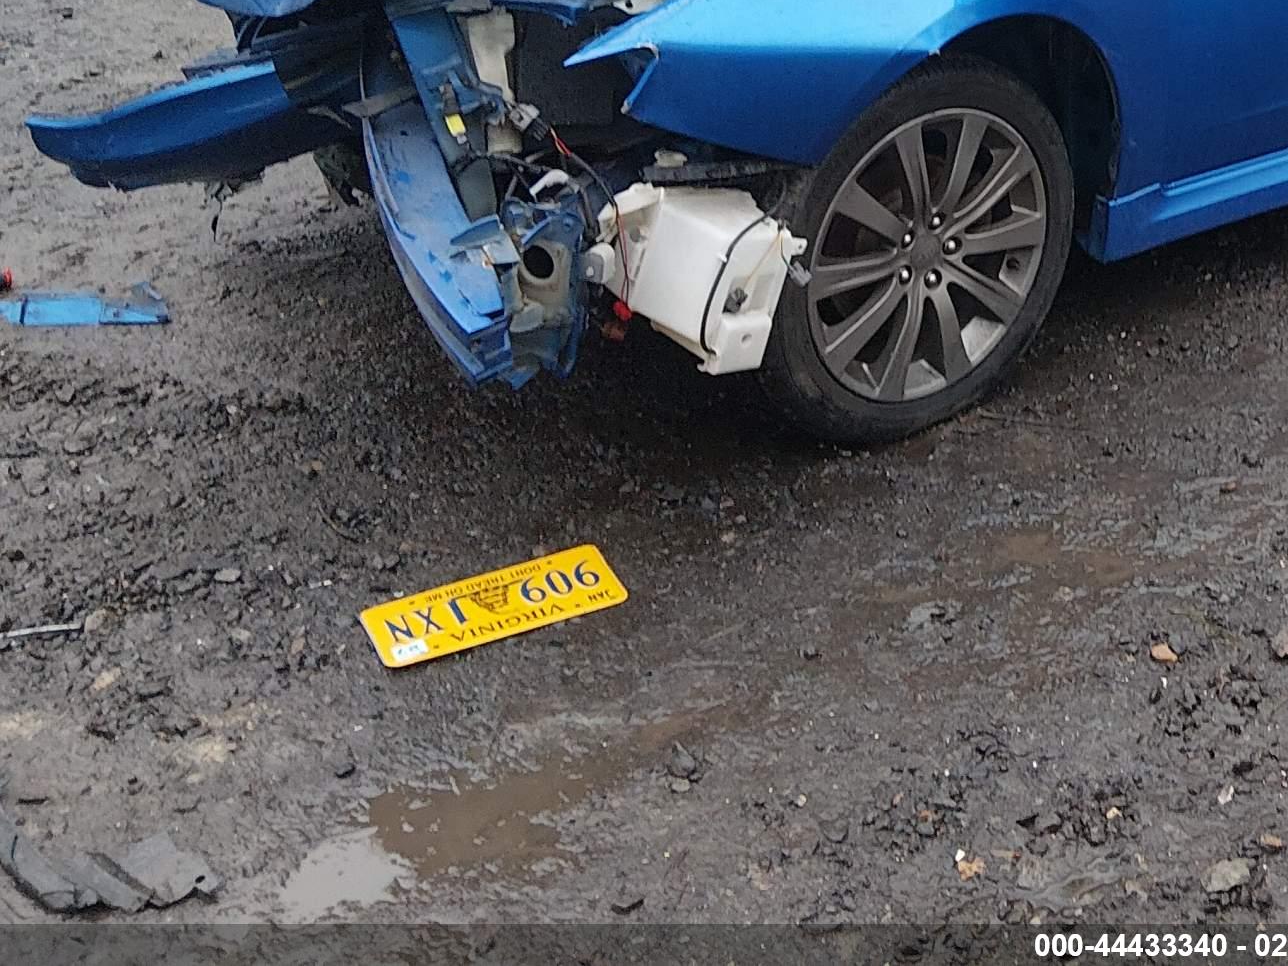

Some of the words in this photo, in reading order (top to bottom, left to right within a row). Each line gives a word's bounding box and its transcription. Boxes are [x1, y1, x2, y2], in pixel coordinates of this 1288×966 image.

[466, 574, 506, 592] TREAD
[519, 559, 601, 604] 909
[450, 602, 565, 643] VIRGINIA
